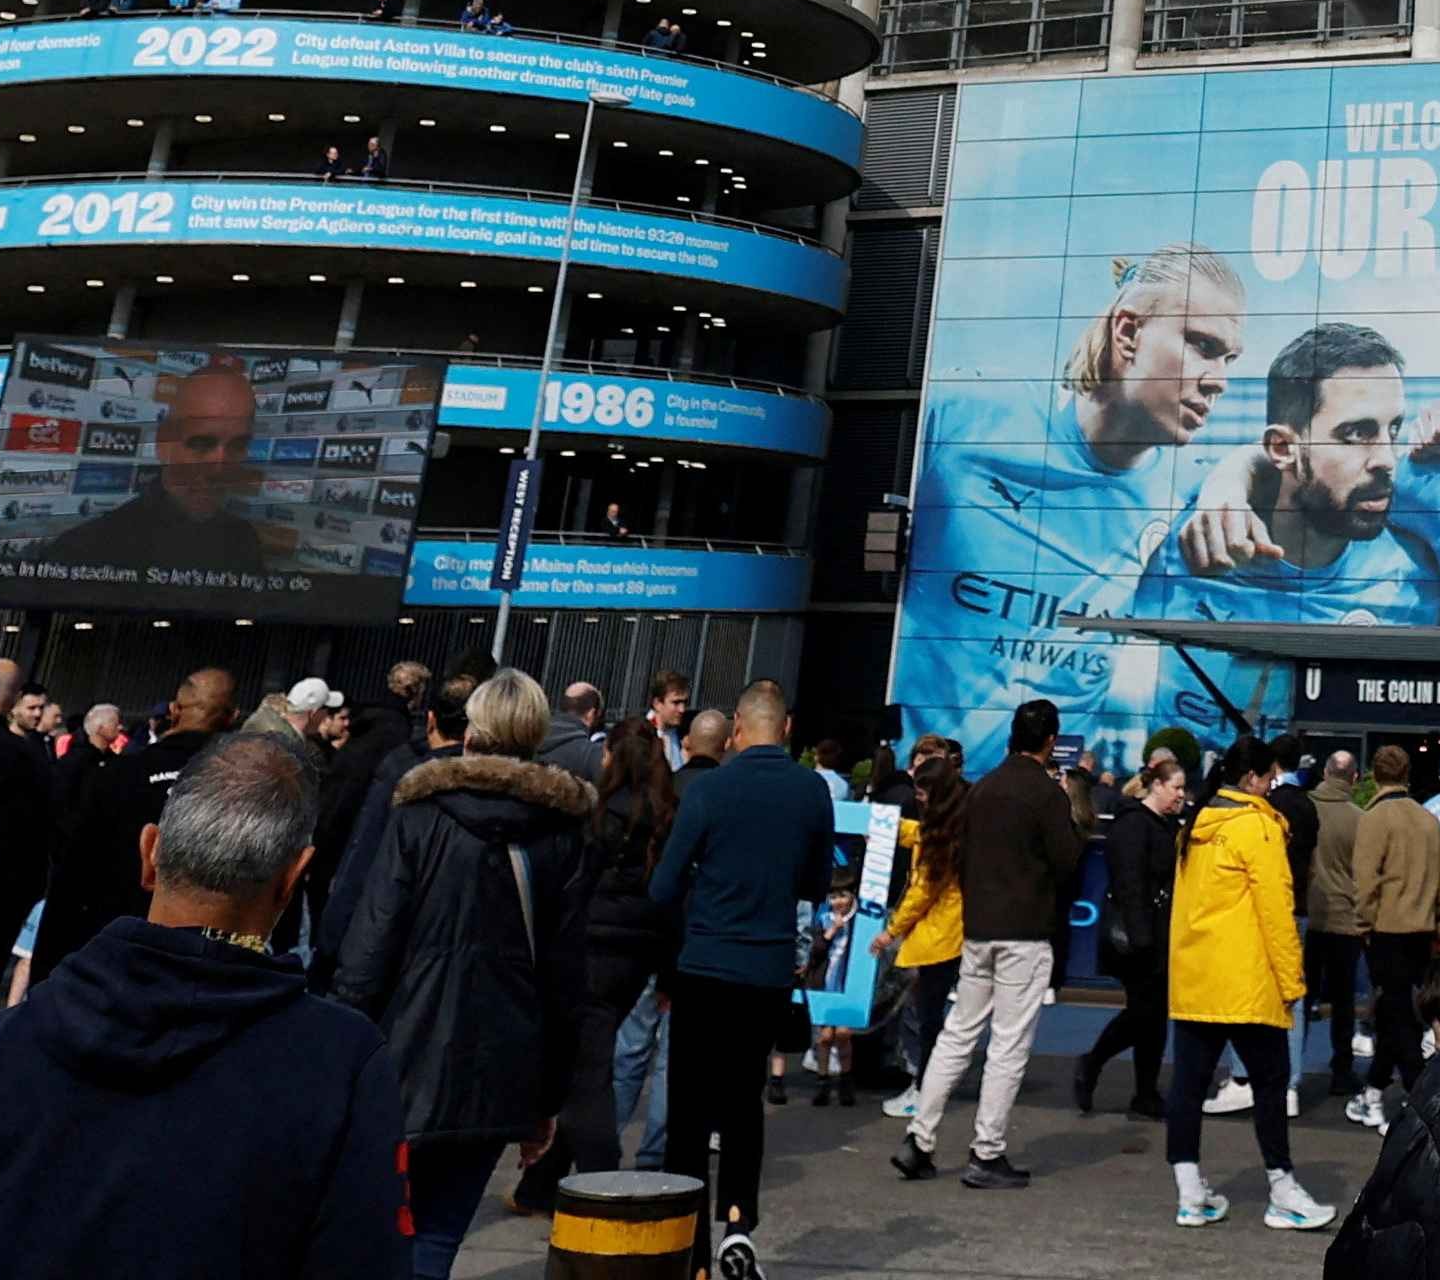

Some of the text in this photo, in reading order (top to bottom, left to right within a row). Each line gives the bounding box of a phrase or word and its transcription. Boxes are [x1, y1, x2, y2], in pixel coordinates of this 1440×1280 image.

[133, 26, 689, 90] 2022 City defeat Aston Villa to secure the sixth Premier
[292, 50, 697, 108] League title following another dramatic goals
[37, 191, 647, 241] 2012 City win the Premier League for the first time the historic
[188, 213, 676, 264] that saw Sergio score an iconic goal time secure
[1250, 156, 1439, 282] OUR
[29, 352, 89, 379] betway
[543, 380, 656, 429] 1986
[666, 393, 689, 412] City
[514, 468, 530, 506] WEST
[434, 555, 611, 574] City Maine Road
[501, 507, 524, 582] RECEPTION
[989, 634, 1110, 676] AIRWAYS
[1357, 679, 1386, 703] THE
[1387, 680, 1433, 705] COLIN
[859, 801, 901, 903] STONES
